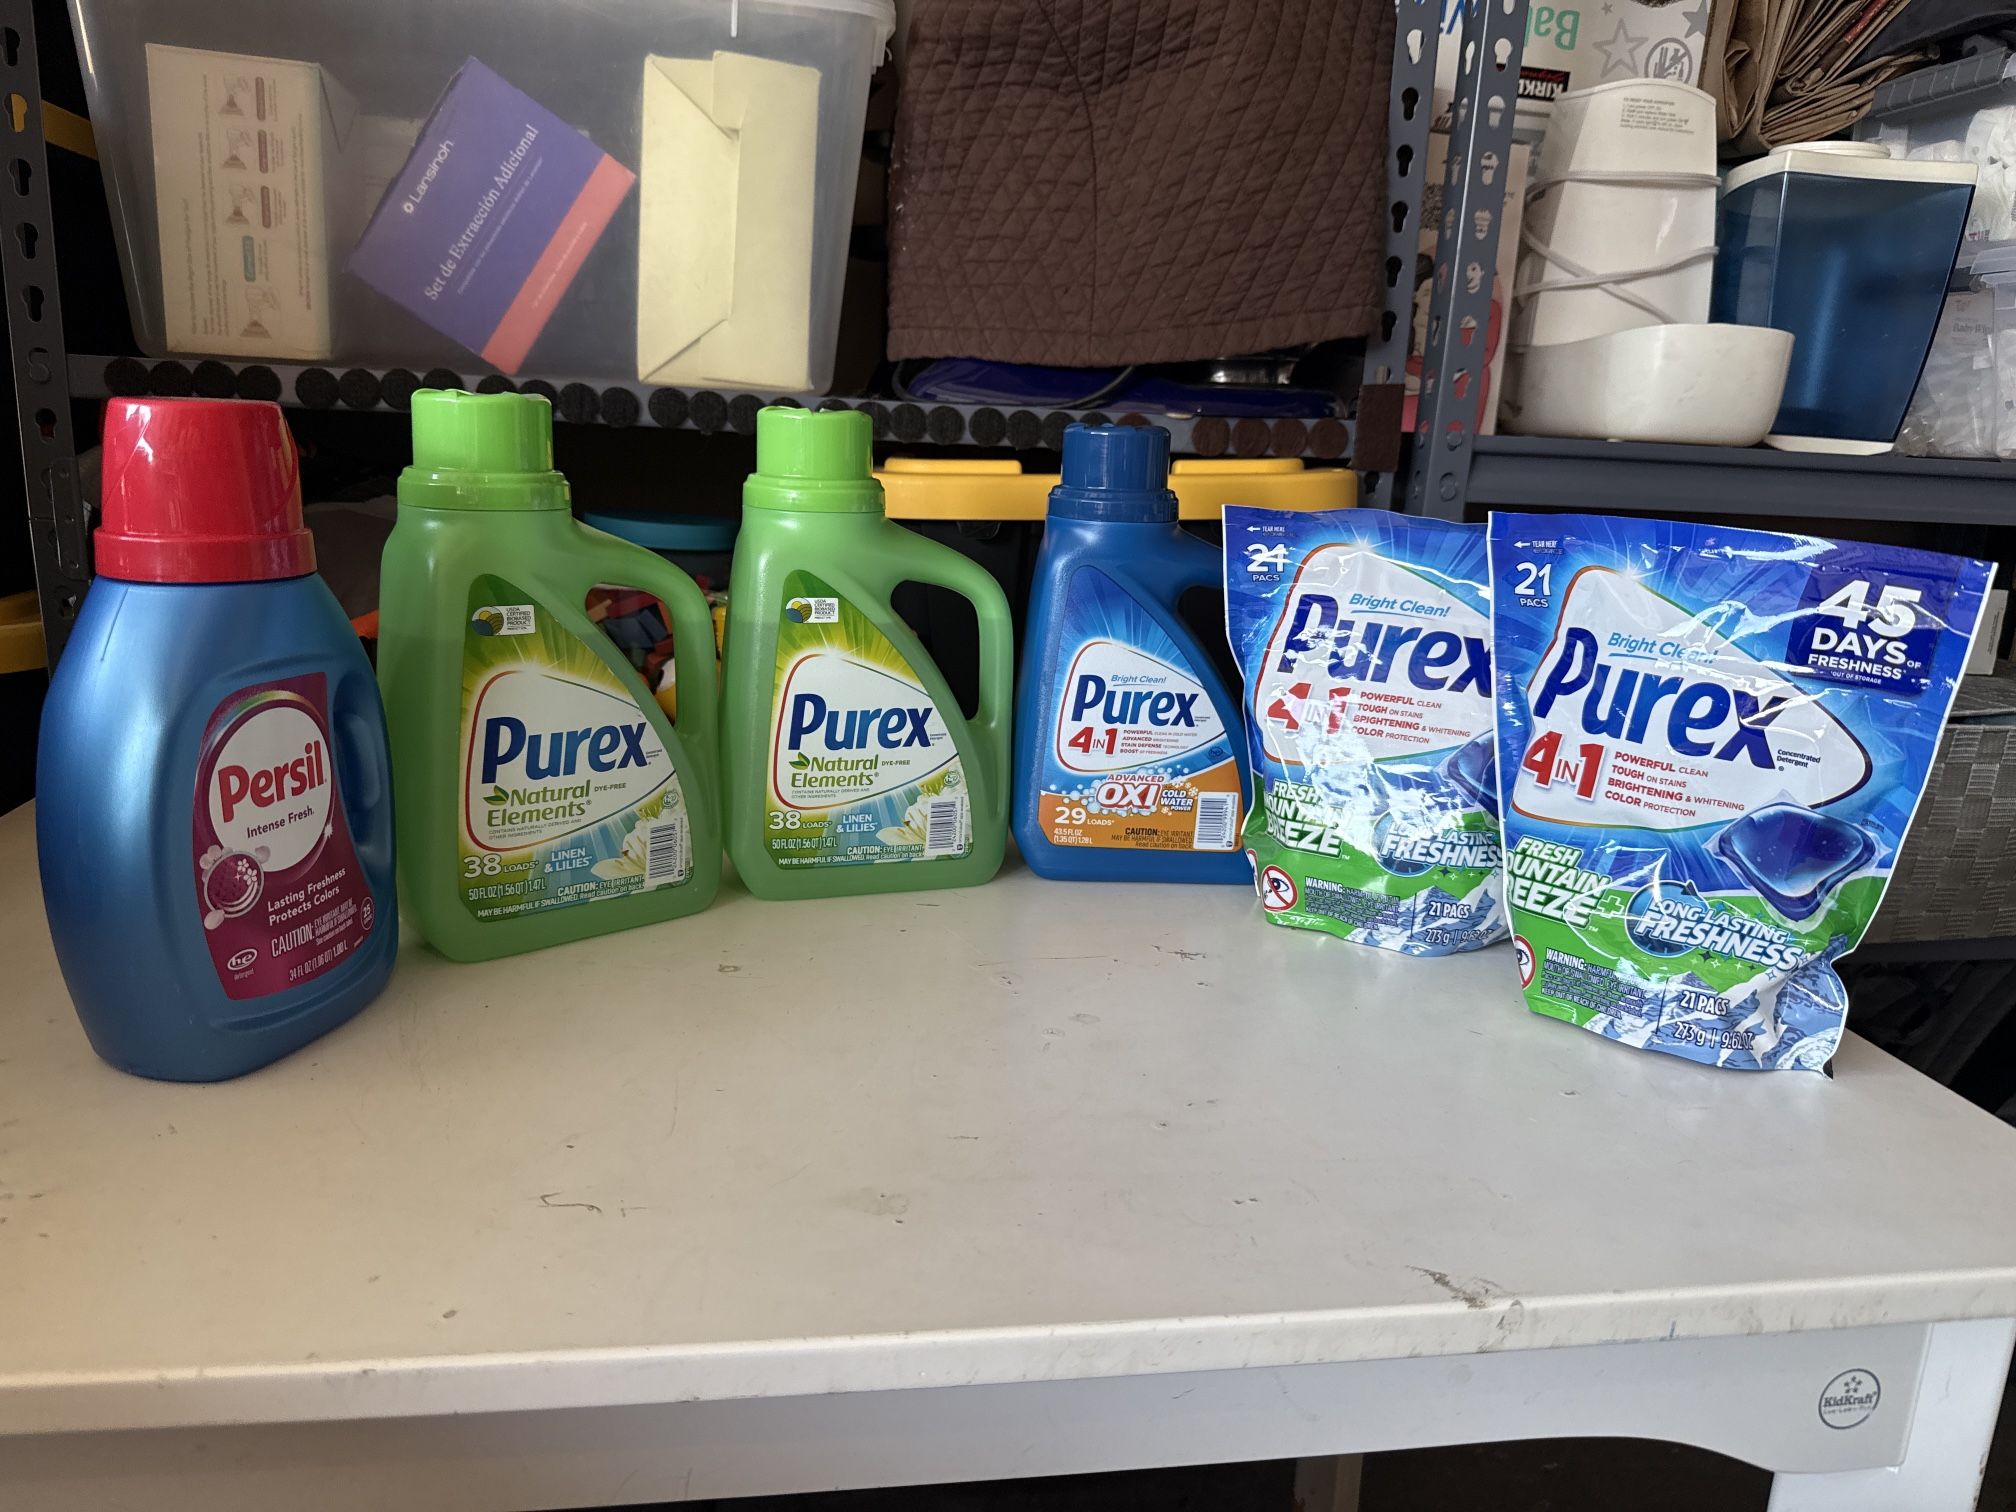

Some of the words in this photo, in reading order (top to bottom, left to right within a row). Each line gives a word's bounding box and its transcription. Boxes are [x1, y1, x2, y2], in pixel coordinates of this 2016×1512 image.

[410, 139, 453, 205] Lansinoh
[424, 279, 446, 301] Set
[439, 257, 457, 279] de
[449, 187, 501, 262] Extracción
[494, 124, 540, 190] Adicional
[1252, 574, 1280, 582] PACS
[1515, 561, 1551, 596] 21
[1349, 593, 1398, 611] Bright
[1400, 600, 1451, 618] Clean!
[1519, 598, 1549, 608] PACS
[1816, 580, 1922, 638] 45
[1277, 593, 1493, 699] Purex
[1607, 632, 1657, 654] Bright
[1658, 641, 1719, 665] Clean!
[1811, 627, 1908, 665] DAYS
[1907, 660, 1922, 669] OF
[1111, 675, 1138, 684] Bright
[1139, 676, 1167, 684] Clean!
[1854, 674, 1882, 685] STORAGE
[1071, 674, 1199, 727] Purex
[1360, 691, 1415, 706] POWERFUL
[1417, 699, 1442, 710] CLEAN
[1533, 627, 1792, 770] Purex
[1357, 703, 1388, 715] TOUGH
[1388, 708, 1399, 716] ON
[1400, 709, 1424, 719] STAINS
[788, 693, 933, 751] Purex
[1428, 726, 1471, 738] WHITENING
[1385, 732, 1430, 744] PROTECTION
[481, 716, 648, 784] Purex
[1777, 749, 1821, 764] Concentrated
[810, 754, 879, 772] Natural
[1614, 751, 1676, 773] POWERFUL
[1678, 766, 1709, 778] CLEAN
[1776, 755, 1809, 769] Detergent
[217, 740, 324, 823] Persil
[791, 773, 875, 788] Elements
[1107, 774, 1165, 783] ADVANCED
[1611, 764, 1645, 781] TOUGH
[1646, 775, 1658, 784] ON
[1658, 777, 1687, 789] STAINS
[511, 779, 591, 806] Natural
[594, 782, 627, 793] DYE-FREE
[1097, 781, 1162, 809] OXI
[1160, 797, 1193, 806] WATER
[1161, 789, 1187, 798] COLD
[1273, 781, 1319, 804] FRESH
[1607, 777, 1683, 801] BRIGHTENING
[1693, 796, 1745, 811] WHITENING
[1604, 791, 1641, 807] COLOR
[1643, 802, 1696, 817] PROTECTION
[487, 805, 587, 828] Elements
[769, 811, 801, 830] 38
[842, 814, 873, 824] LINEN
[1055, 806, 1087, 825] 29
[247, 819, 286, 839] Intense
[836, 825, 844, 833] &
[846, 823, 876, 832] LILIES
[1125, 828, 1160, 836] CAUTION:
[772, 839, 781, 850] 50
[781, 839, 788, 849] FL
[788, 838, 797, 849] OZ
[847, 846, 882, 855] CAUTION:
[1381, 834, 1504, 868] FRESHNESS
[1516, 837, 1581, 867] FRESH
[544, 864, 553, 873] &
[555, 857, 591, 872] LILIES
[551, 848, 586, 862] LINEN
[800, 856, 827, 864] HARMFUL
[463, 853, 502, 878] 38
[267, 890, 305, 912] Lasting
[307, 868, 346, 895] Freshness
[468, 889, 478, 901] 50
[478, 887, 487, 899] FL
[487, 886, 498, 899] OZ
[557, 882, 599, 897] CAUTION:
[1305, 877, 1345, 893] WARNING:
[269, 901, 312, 926] Protects
[314, 886, 340, 905] Colors
[363, 904, 371, 918] 25
[477, 909, 492, 918] MAY
[493, 907, 502, 916] BE
[502, 903, 533, 915] HARMFUL
[1428, 901, 1441, 916] 21
[1443, 903, 1471, 918] PACS
[1508, 874, 1597, 928] EEZE
[1648, 897, 1789, 942] LONG-LASTING
[271, 922, 315, 957] CAUTION:
[1425, 929, 1442, 943] 273
[1443, 932, 1450, 947] g
[1635, 913, 1804, 972] FRESHNESS
[1546, 947, 1587, 971] WARNING:
[289, 966, 297, 981] 34
[297, 964, 305, 977] FL
[304, 960, 312, 974] OZ
[1680, 990, 1697, 1009] 21
[1697, 995, 1730, 1016] PACS
[1674, 1021, 1696, 1041] 273
[1696, 1029, 1706, 1046] g
[1823, 1393, 1874, 1408] KidKraft
